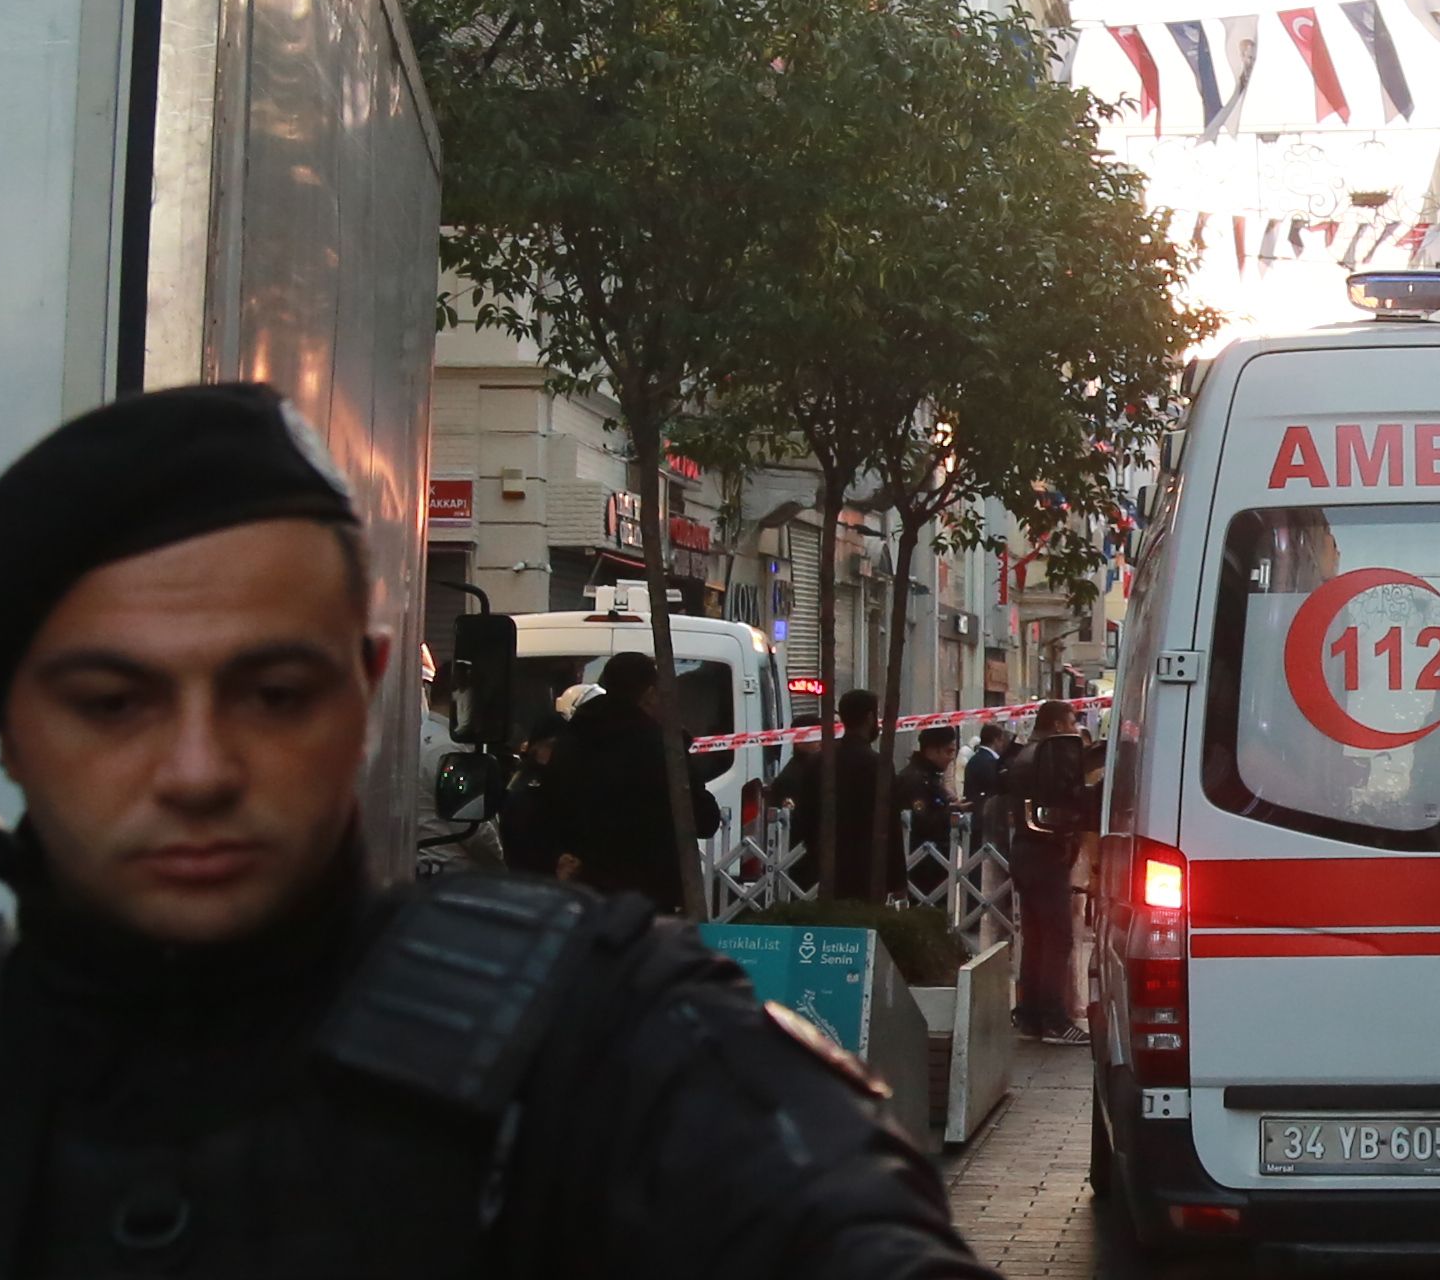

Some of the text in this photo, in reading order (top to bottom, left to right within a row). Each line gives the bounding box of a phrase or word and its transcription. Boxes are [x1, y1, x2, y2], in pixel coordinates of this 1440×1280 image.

[820, 953, 853, 965] Senin
[1283, 1126, 1326, 1160] 34
[1338, 1126, 1380, 1160] YB
